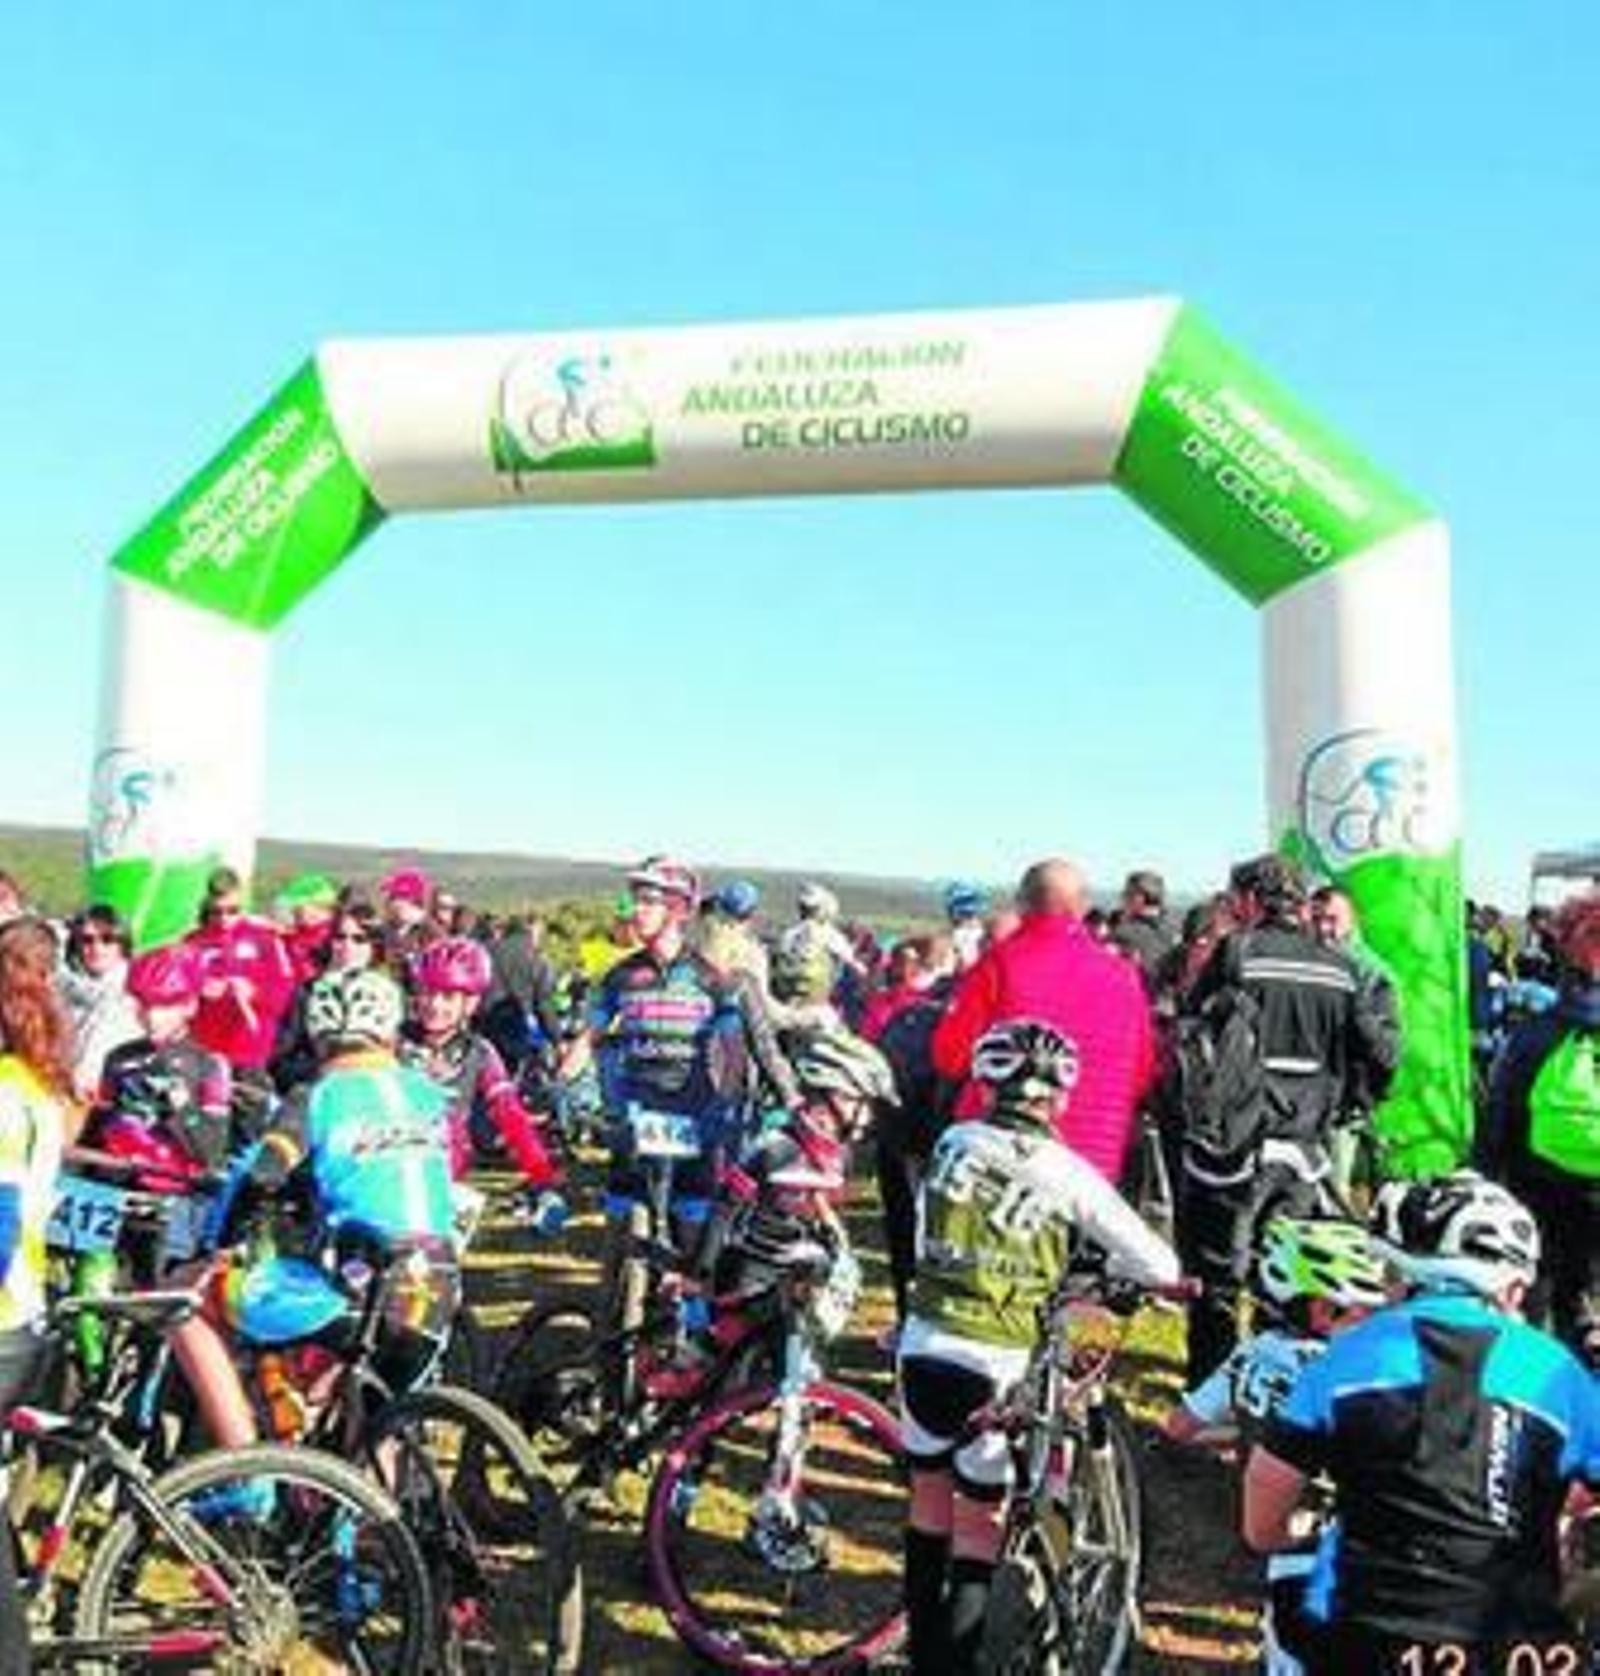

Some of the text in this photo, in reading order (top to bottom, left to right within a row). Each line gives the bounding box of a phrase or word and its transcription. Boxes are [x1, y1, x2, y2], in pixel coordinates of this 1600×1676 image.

[681, 379, 879, 415] ANDALUZA
[741, 411, 971, 450] DE CICLISMO
[1181, 432, 1223, 473] DE
[1215, 463, 1333, 564] CICLISMO
